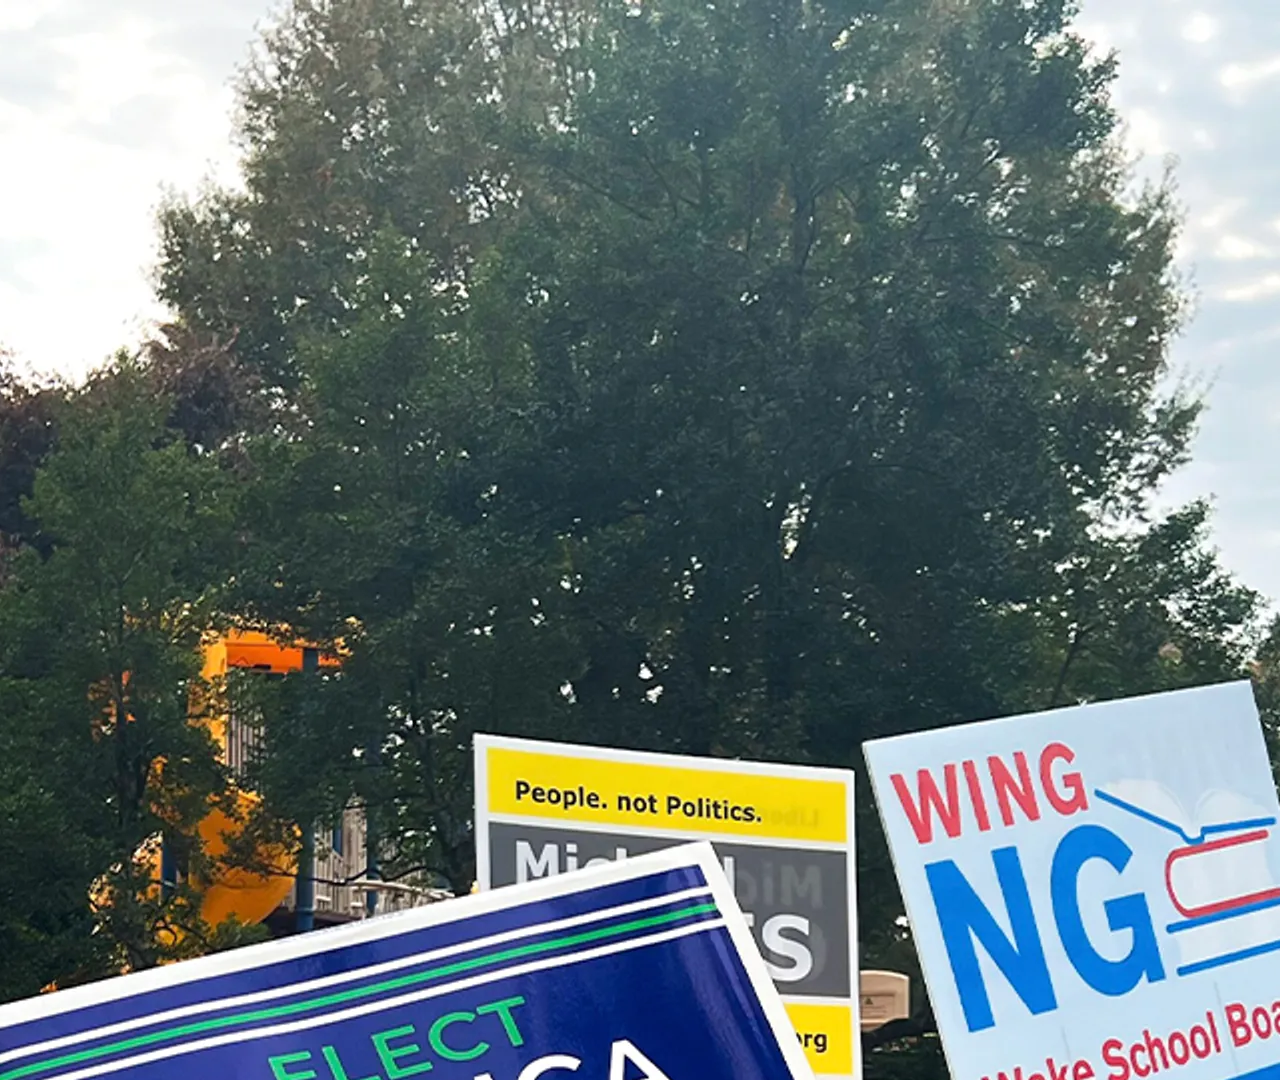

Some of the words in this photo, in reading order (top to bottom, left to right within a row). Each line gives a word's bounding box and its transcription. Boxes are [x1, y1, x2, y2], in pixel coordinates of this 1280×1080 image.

[515, 780, 608, 810] People.
[617, 794, 658, 813] not
[667, 796, 762, 822] Politics.
[889, 742, 1089, 844] WING
[924, 823, 1166, 1033] NG
